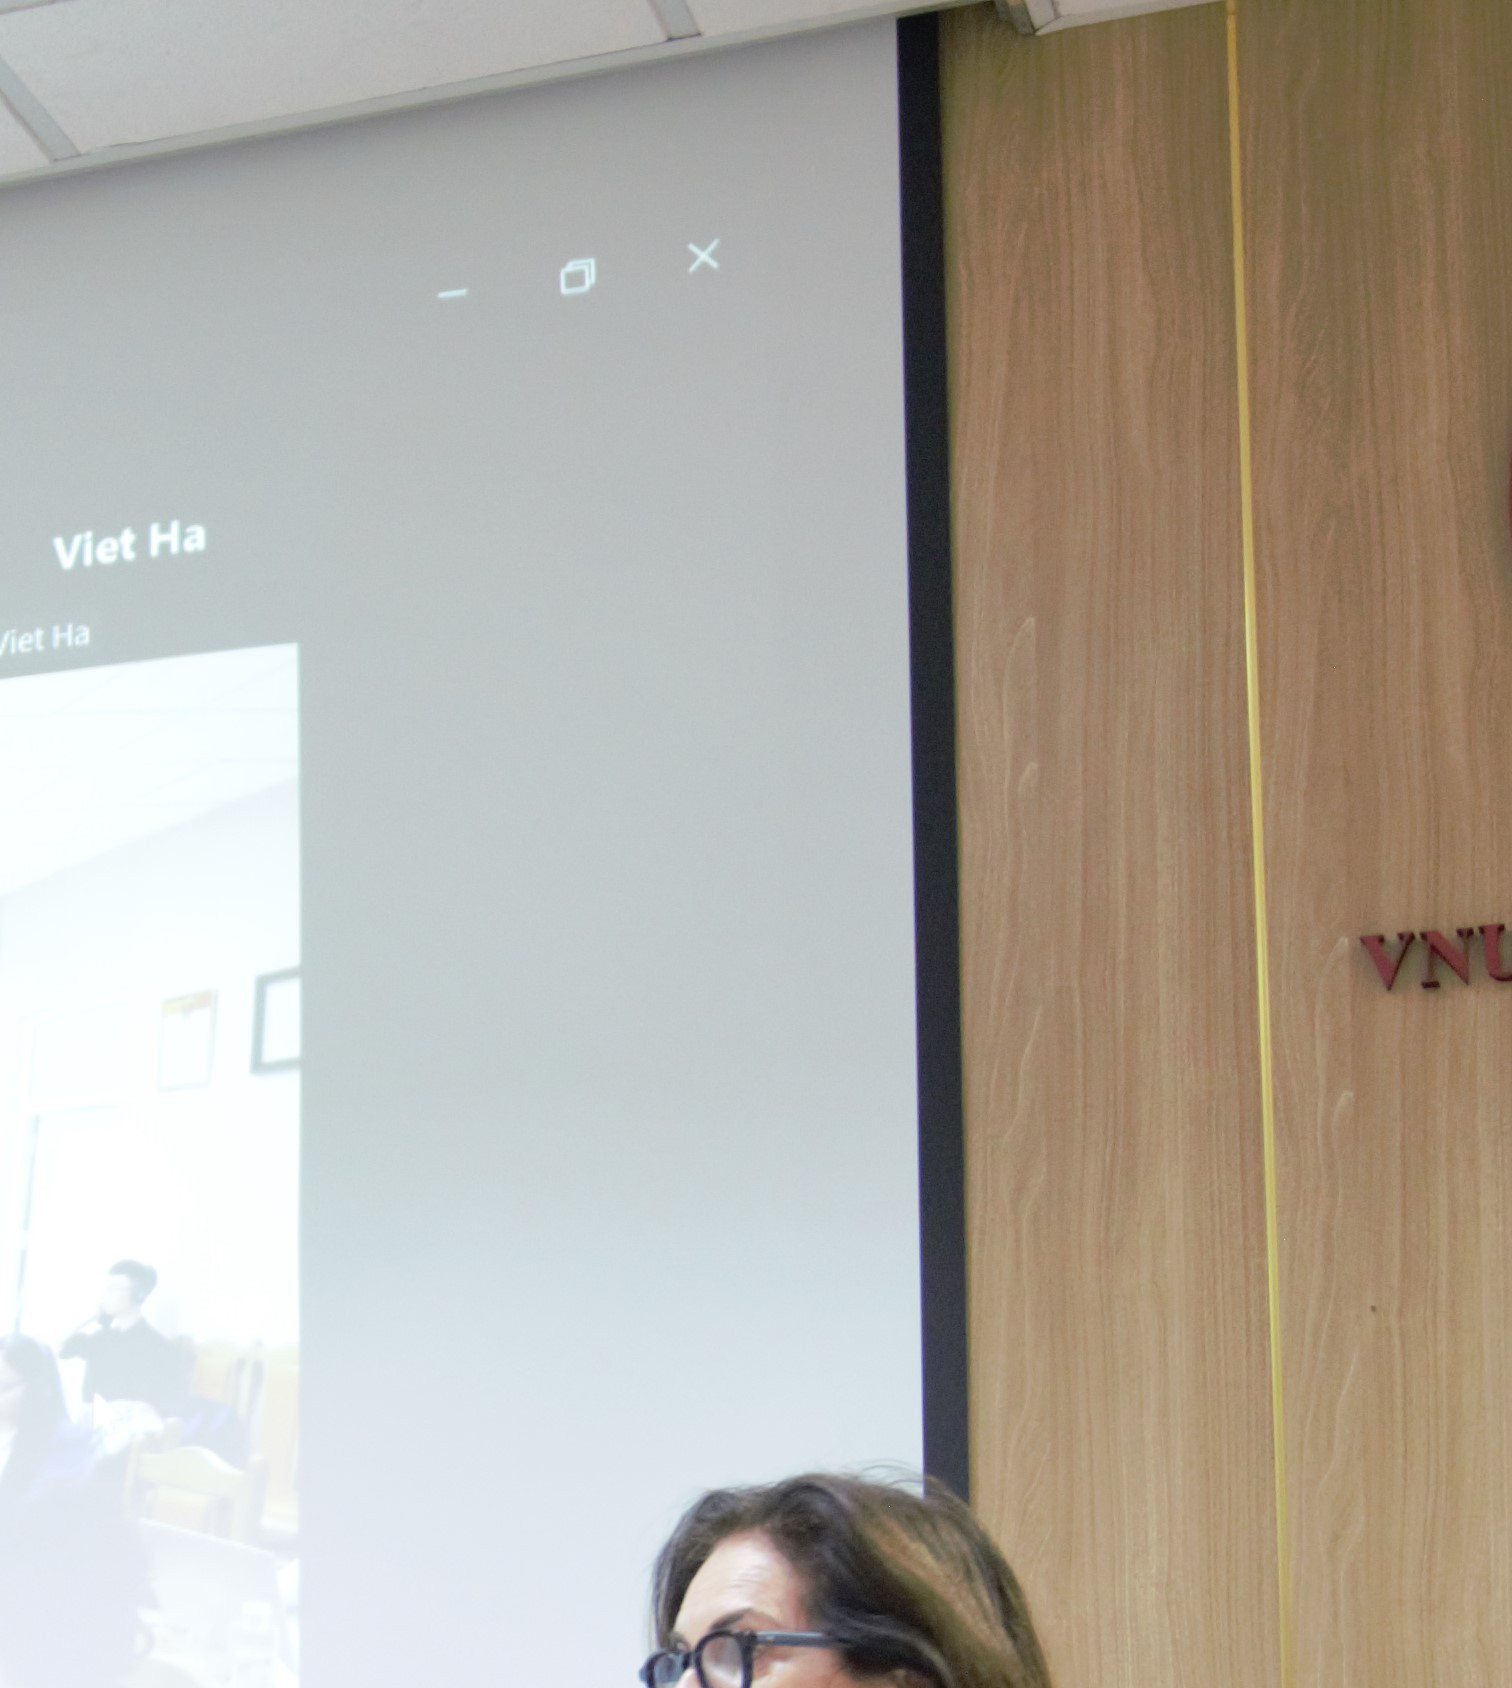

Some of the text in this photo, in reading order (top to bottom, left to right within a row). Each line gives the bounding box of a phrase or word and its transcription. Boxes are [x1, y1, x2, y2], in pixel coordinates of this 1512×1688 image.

[53, 519, 207, 570] Viet Ha
[51, 622, 91, 649] Ha
